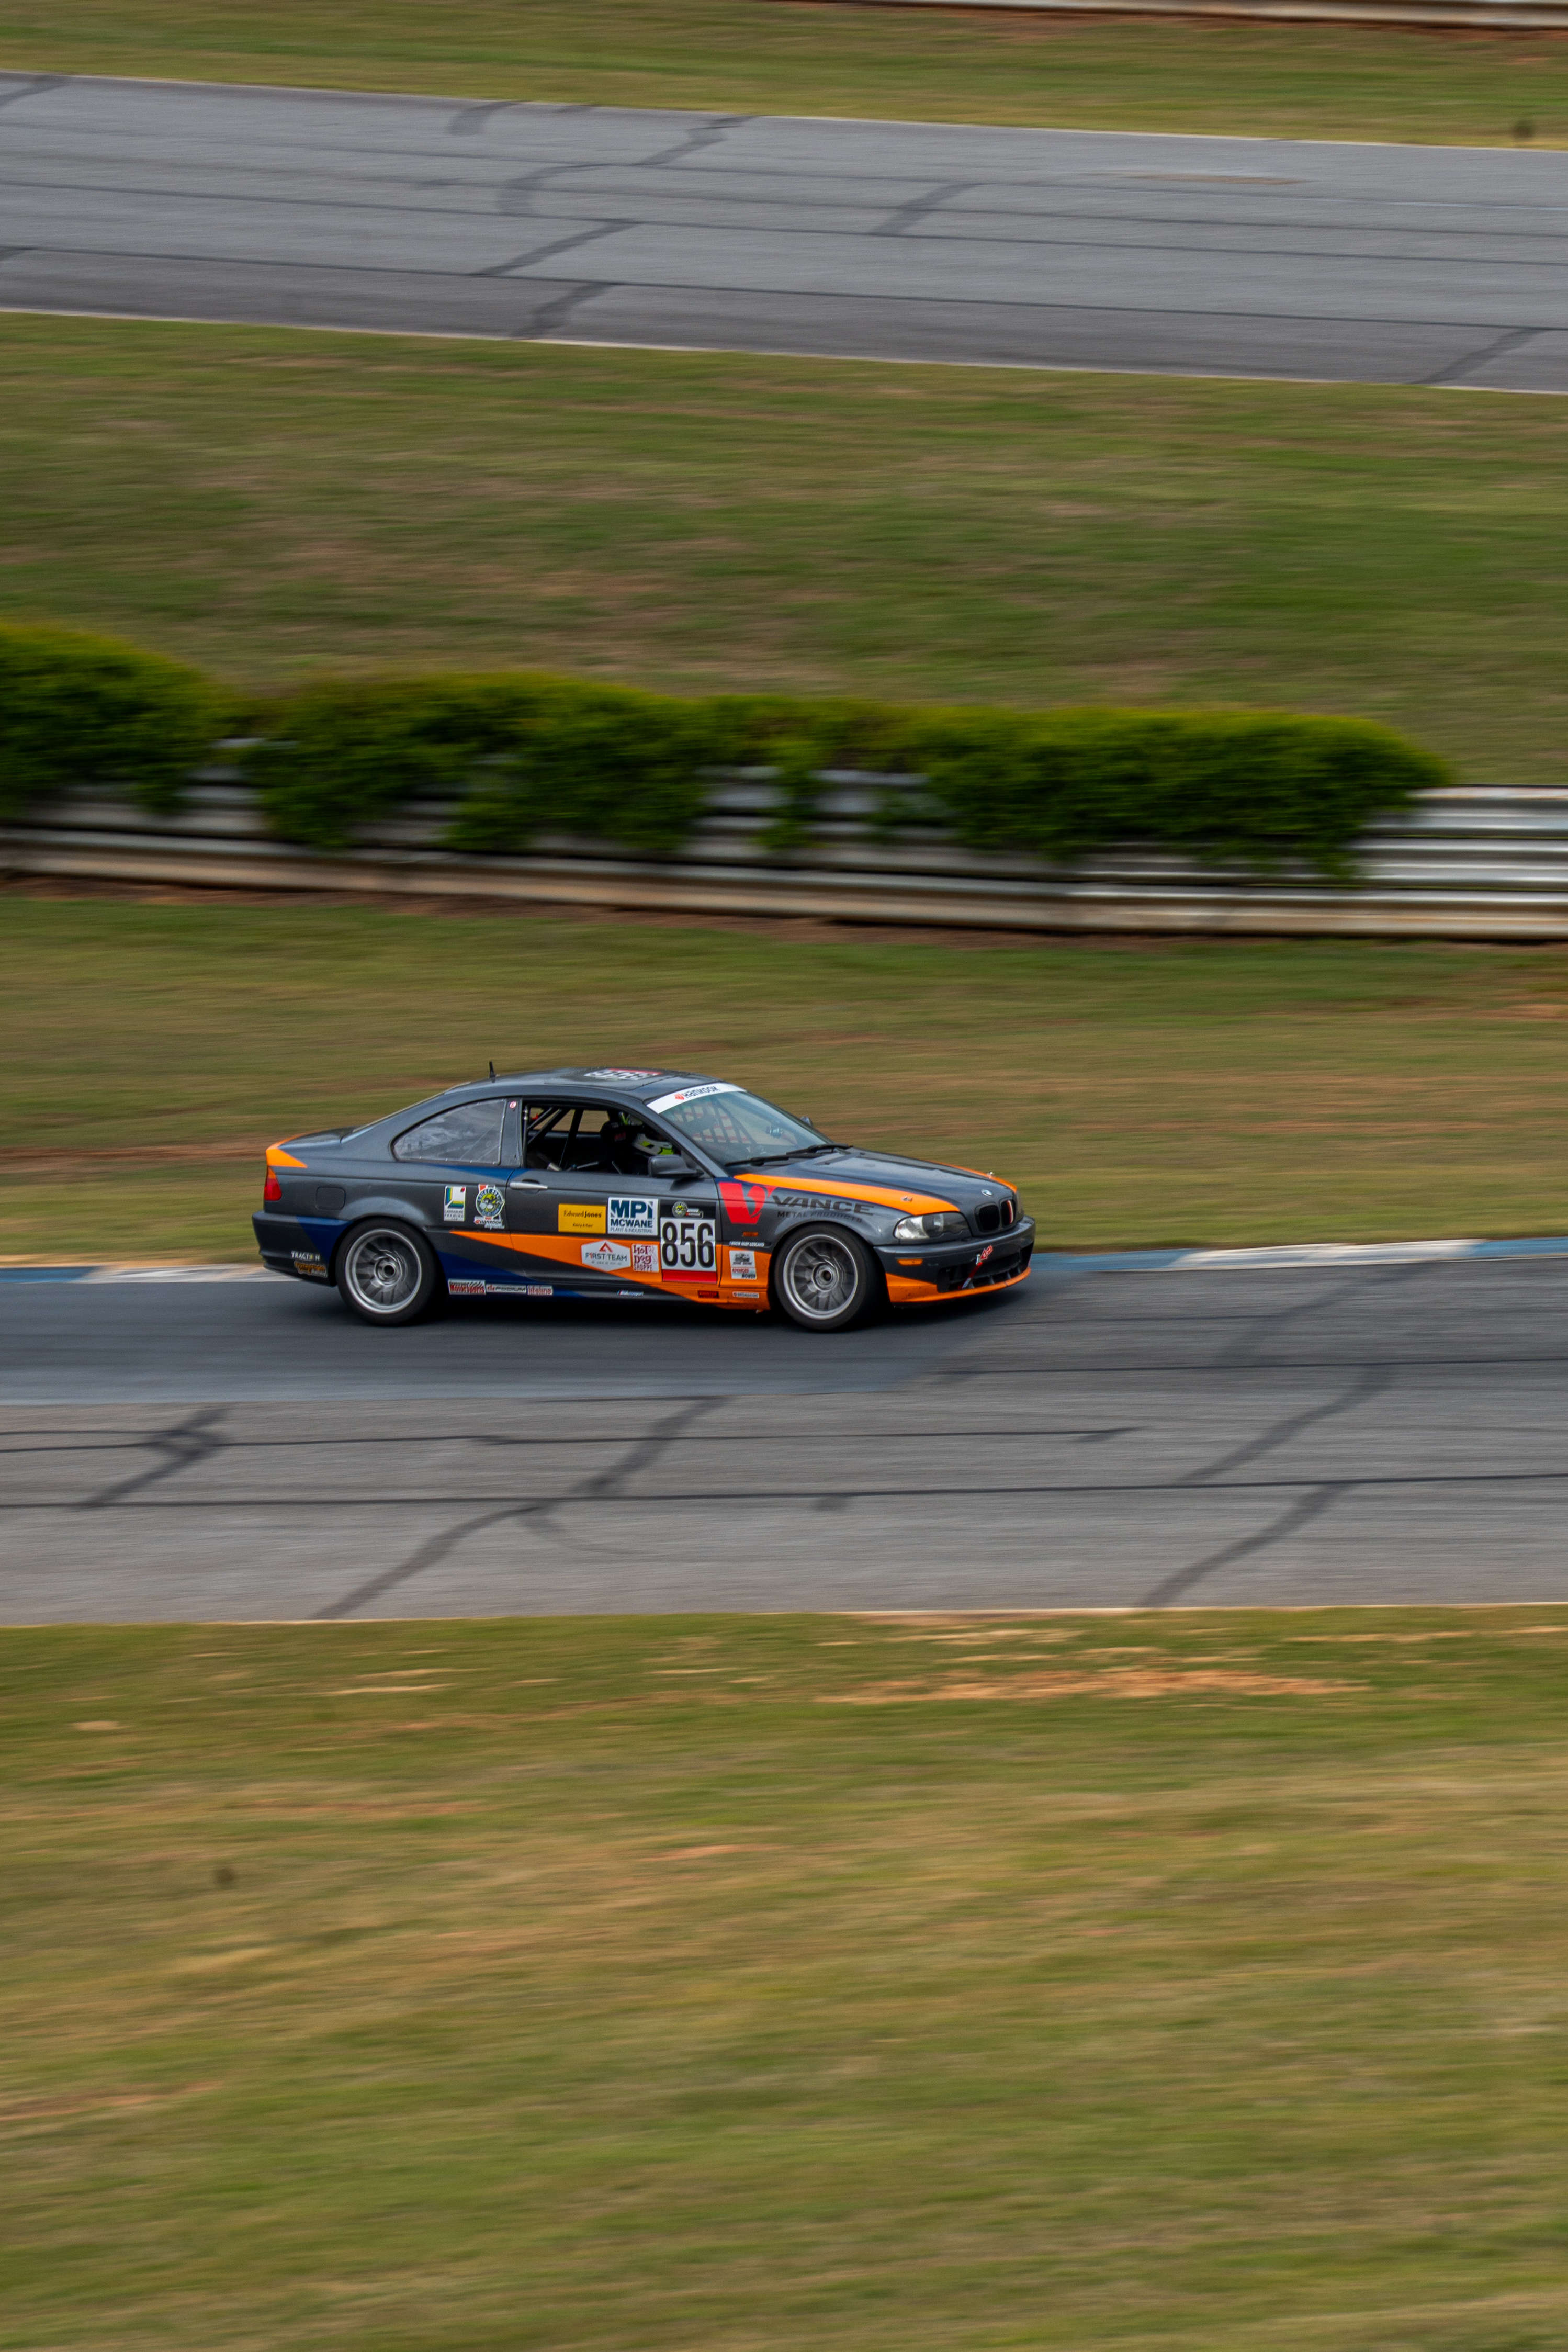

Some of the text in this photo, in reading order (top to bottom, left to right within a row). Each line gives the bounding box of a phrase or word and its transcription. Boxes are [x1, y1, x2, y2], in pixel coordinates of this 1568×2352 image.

[611, 1200, 653, 1219] MPI
[772, 1195, 874, 1216] VANCE
[610, 1219, 653, 1228] MCWANE
[662, 1221, 714, 1268] 856
[450, 1284, 484, 1293] Motorsports
